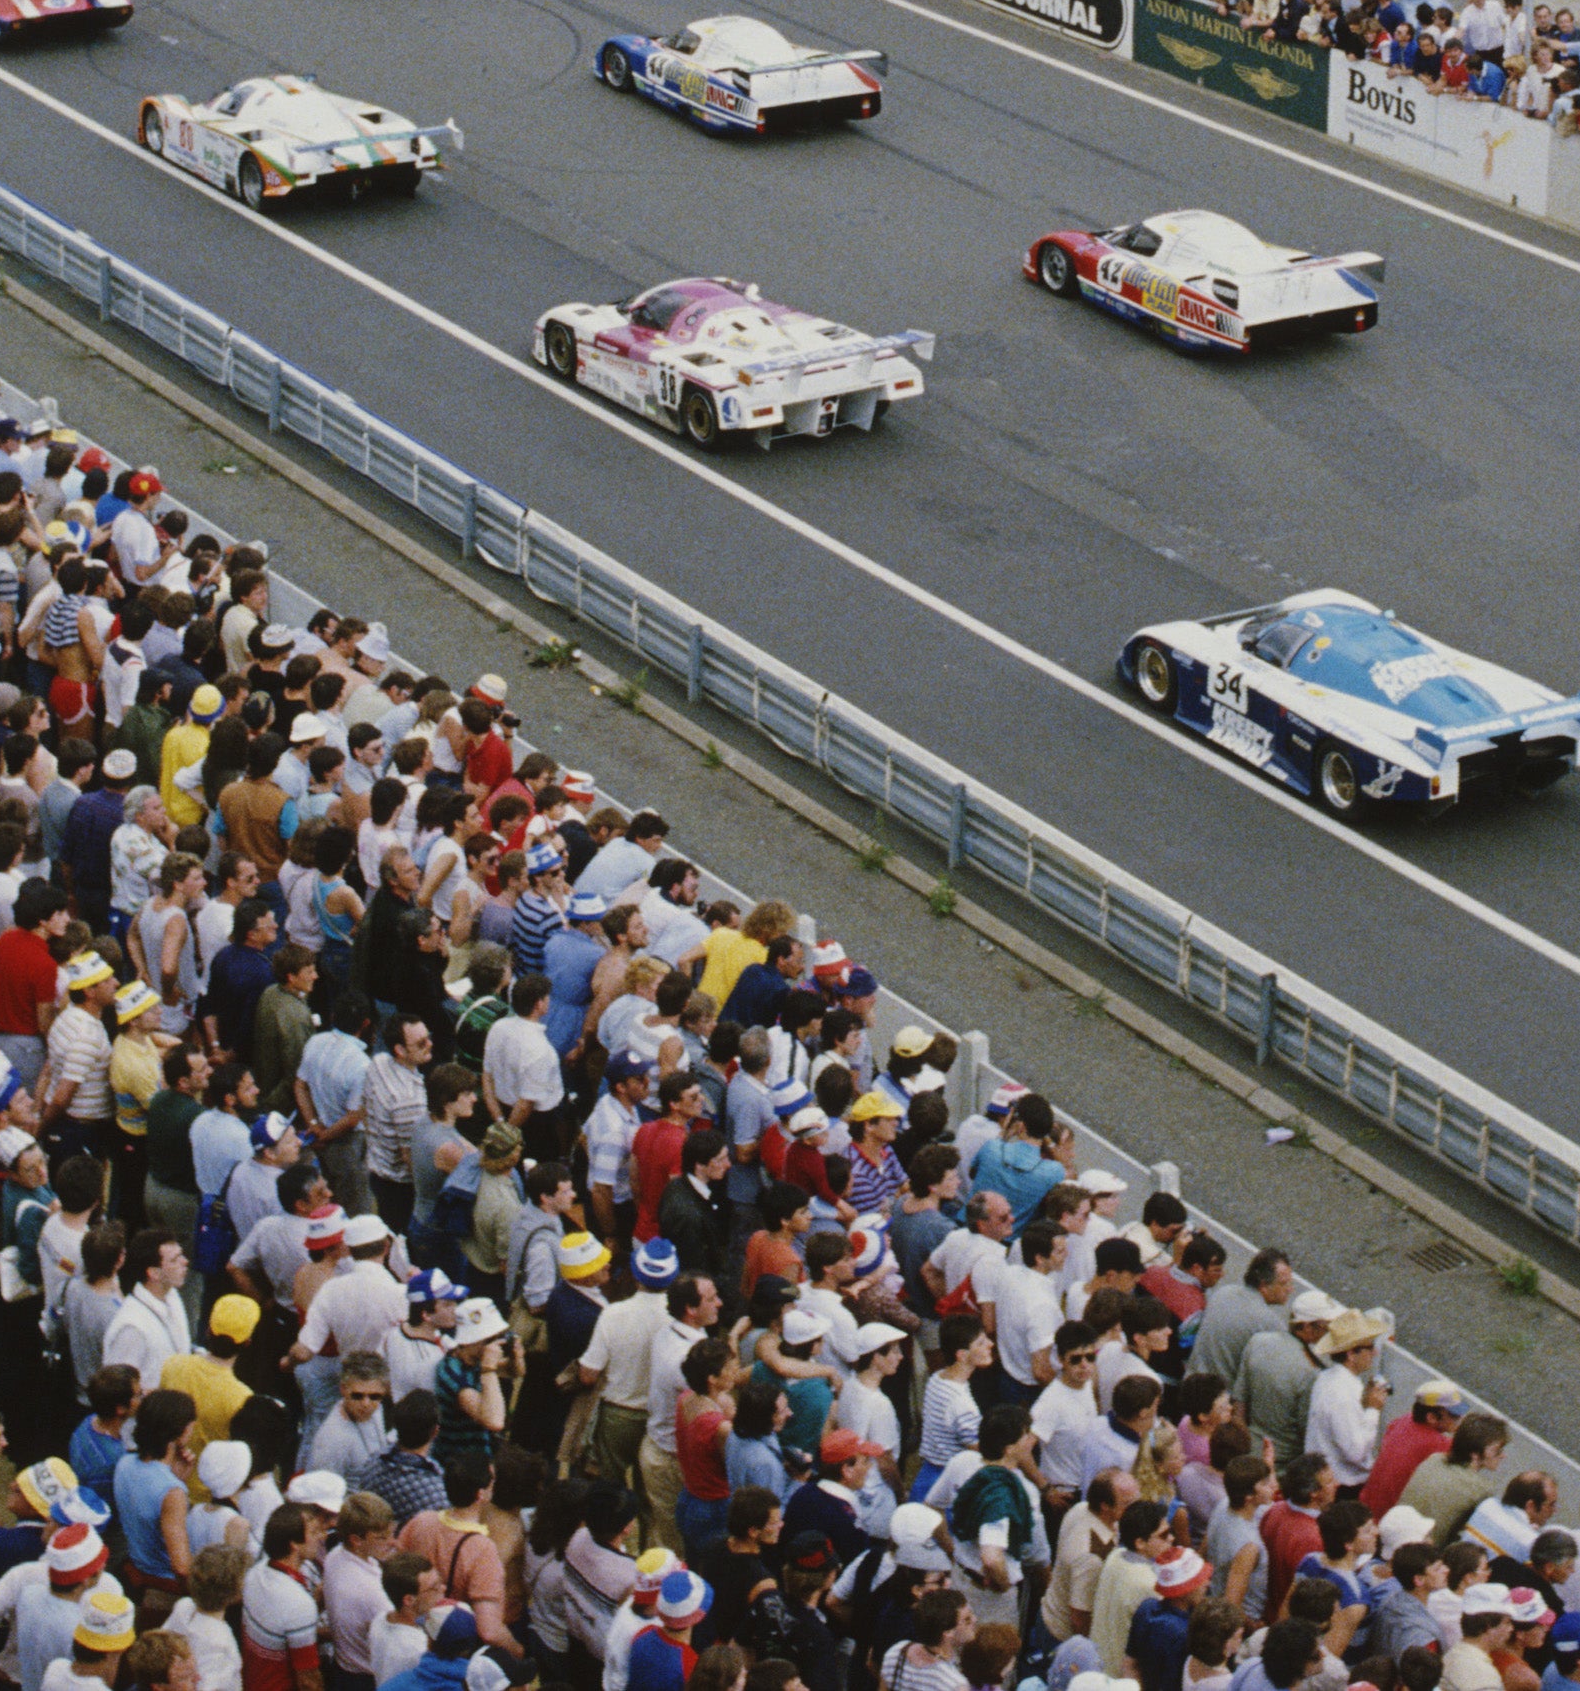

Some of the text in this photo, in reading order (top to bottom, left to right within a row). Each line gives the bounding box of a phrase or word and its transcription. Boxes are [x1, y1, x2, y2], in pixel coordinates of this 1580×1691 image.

[1145, 0, 1315, 72] ASTON MARTIN LAGONDA
[1346, 68, 1418, 126] Bovis
[1100, 257, 1122, 285] 42
[1212, 664, 1244, 706] 34
